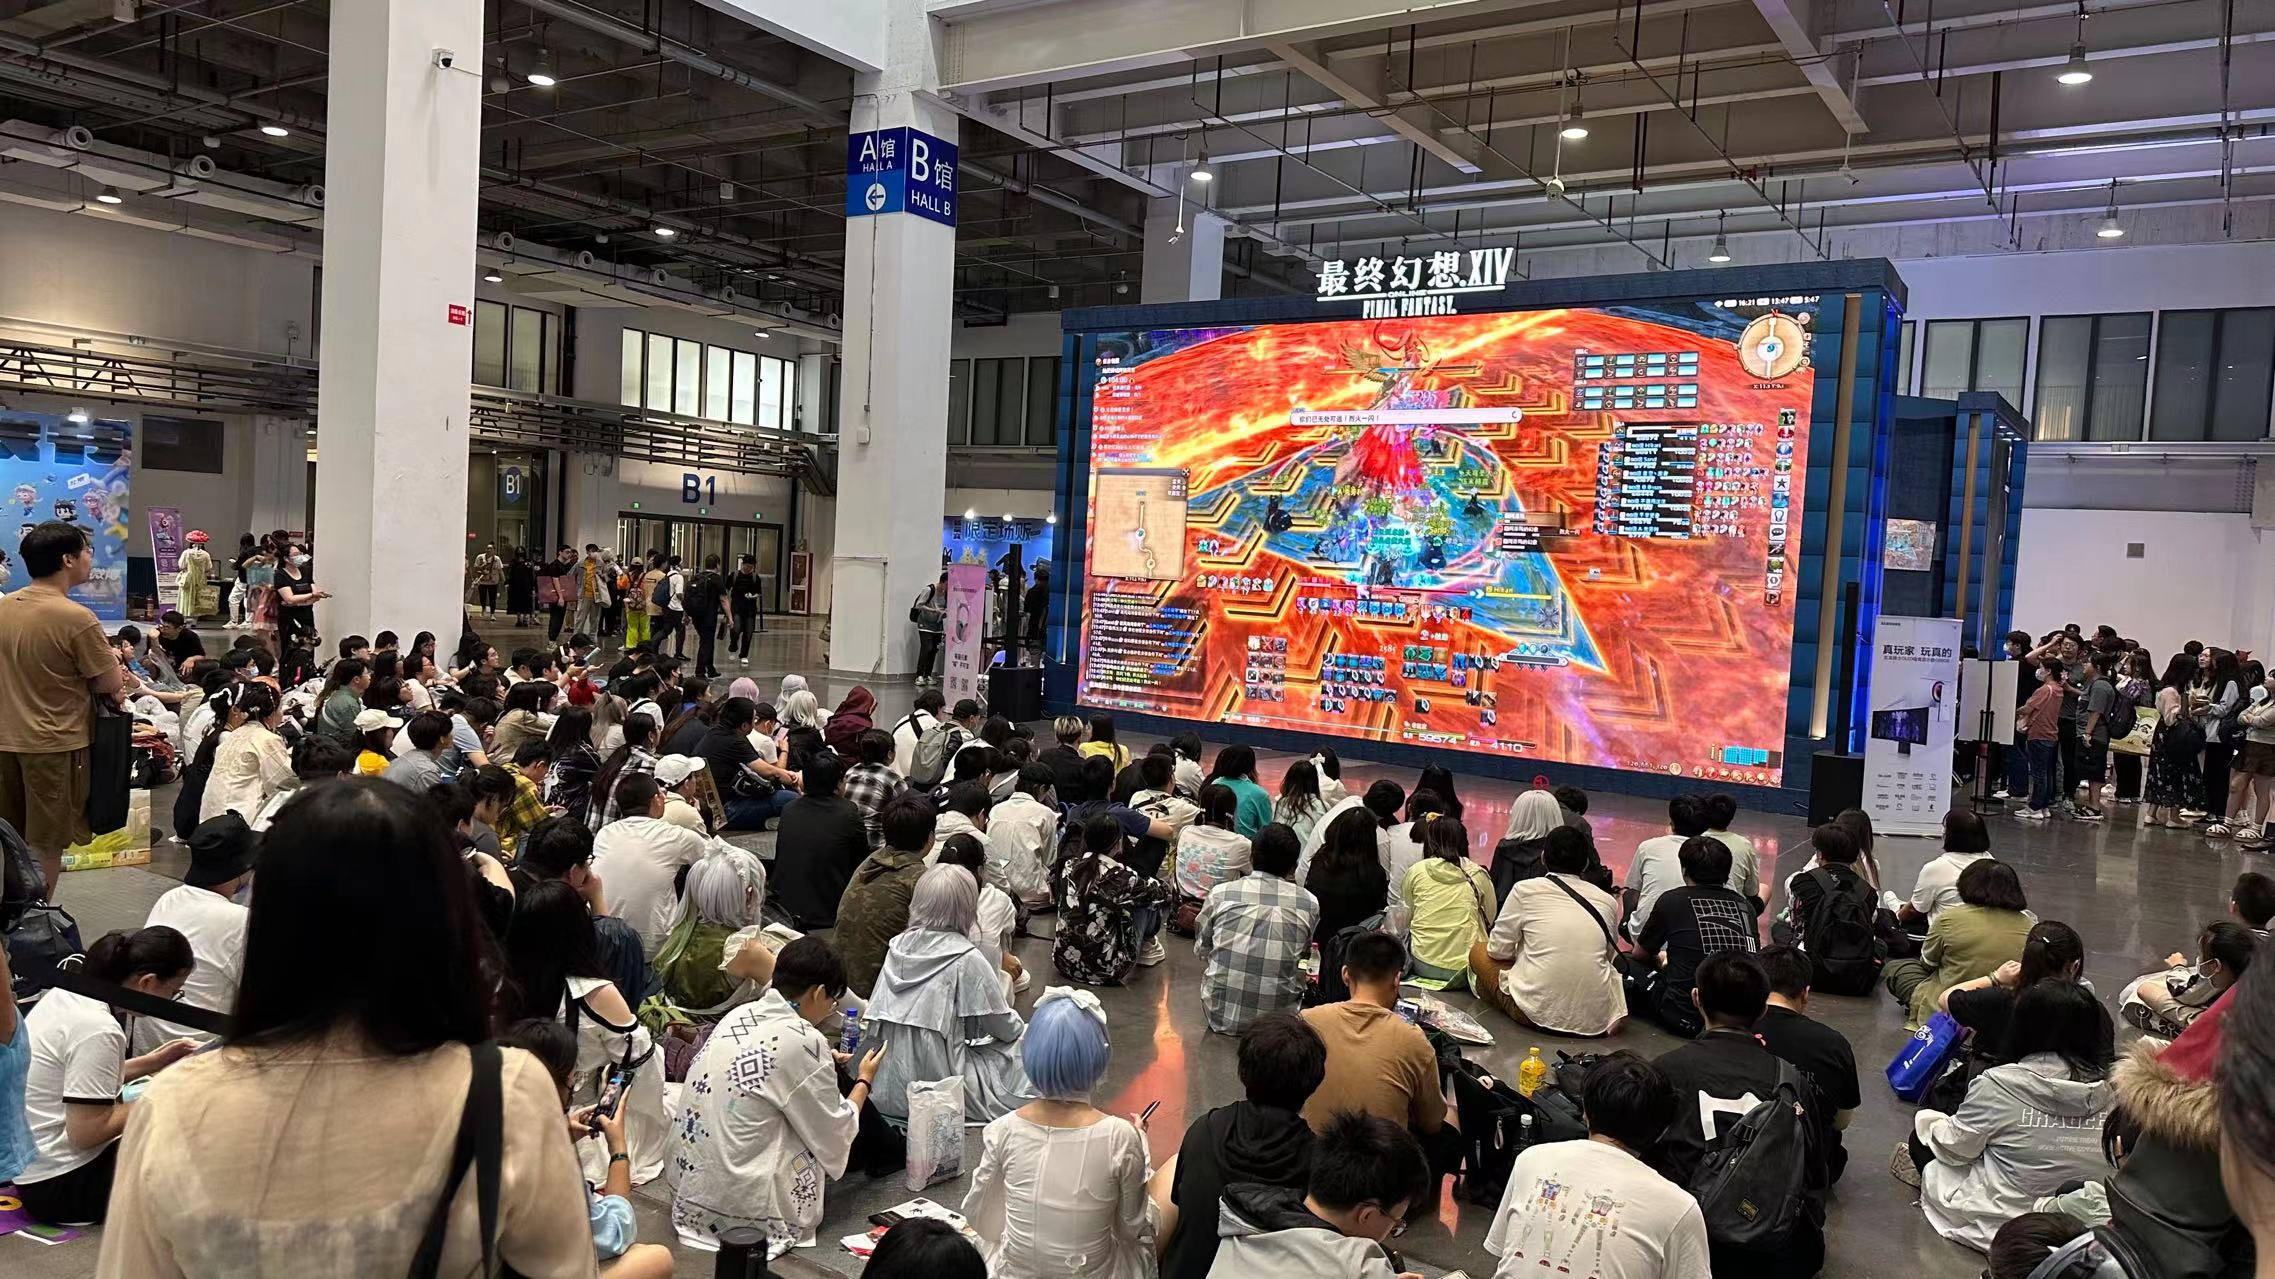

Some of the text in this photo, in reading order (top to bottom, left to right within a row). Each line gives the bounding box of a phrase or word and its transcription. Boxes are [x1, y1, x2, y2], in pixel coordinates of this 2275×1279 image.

[886, 160, 893, 170] A
[911, 138, 954, 192] B馆
[911, 189, 951, 216] HALL B
[1387, 289, 1428, 298] ONLINE
[1362, 299, 1398, 319] FINAL
[506, 474, 521, 495] B1
[682, 473, 716, 505] B1
[1882, 644, 1953, 658] 真玩家 玩真的
[1418, 733, 1457, 745] 59574
[1490, 741, 1523, 753] 4110
